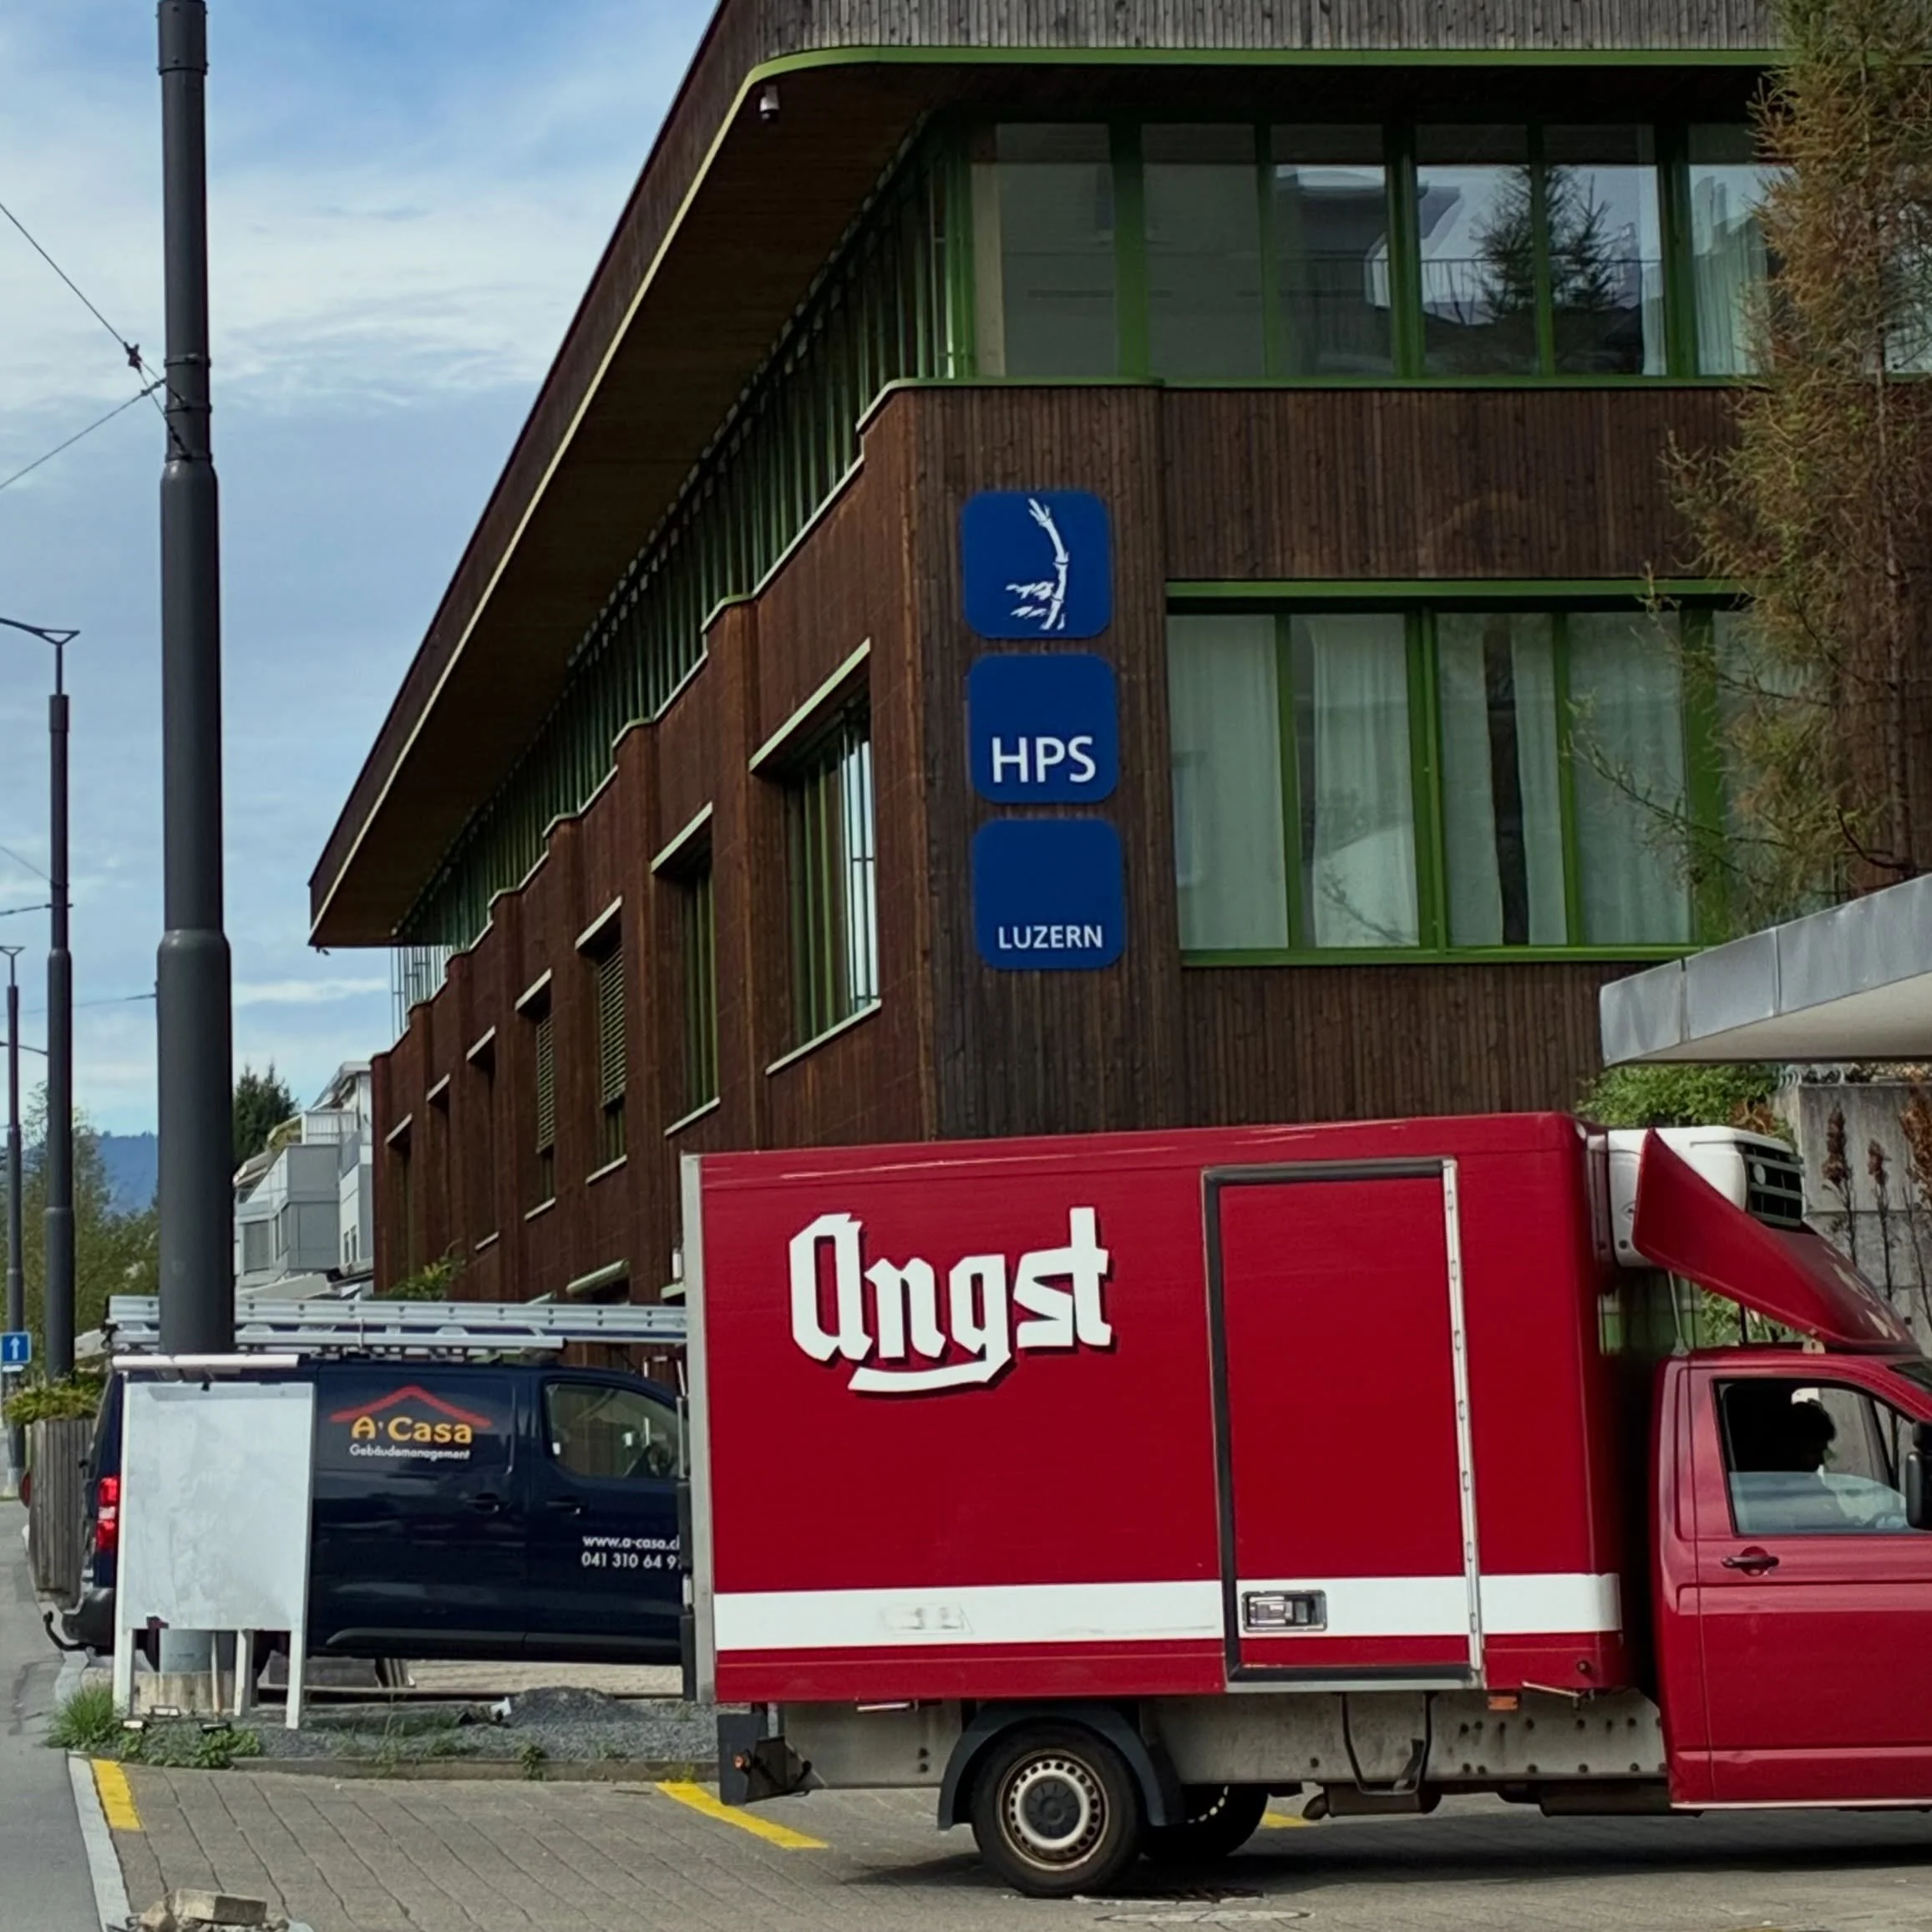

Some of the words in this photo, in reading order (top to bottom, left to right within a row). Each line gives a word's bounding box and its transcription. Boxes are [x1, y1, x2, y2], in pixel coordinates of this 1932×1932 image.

[992, 736, 1096, 783] HPS
[998, 925, 1103, 949] LUZERN
[789, 1207, 1112, 1392] Angst
[349, 1443, 470, 1462] Gebäudemanagement
[581, 1552, 607, 1567] 041
[611, 1553, 639, 1569] 310
[642, 1554, 662, 1569] 64
[666, 1554, 682, 1570] 9
